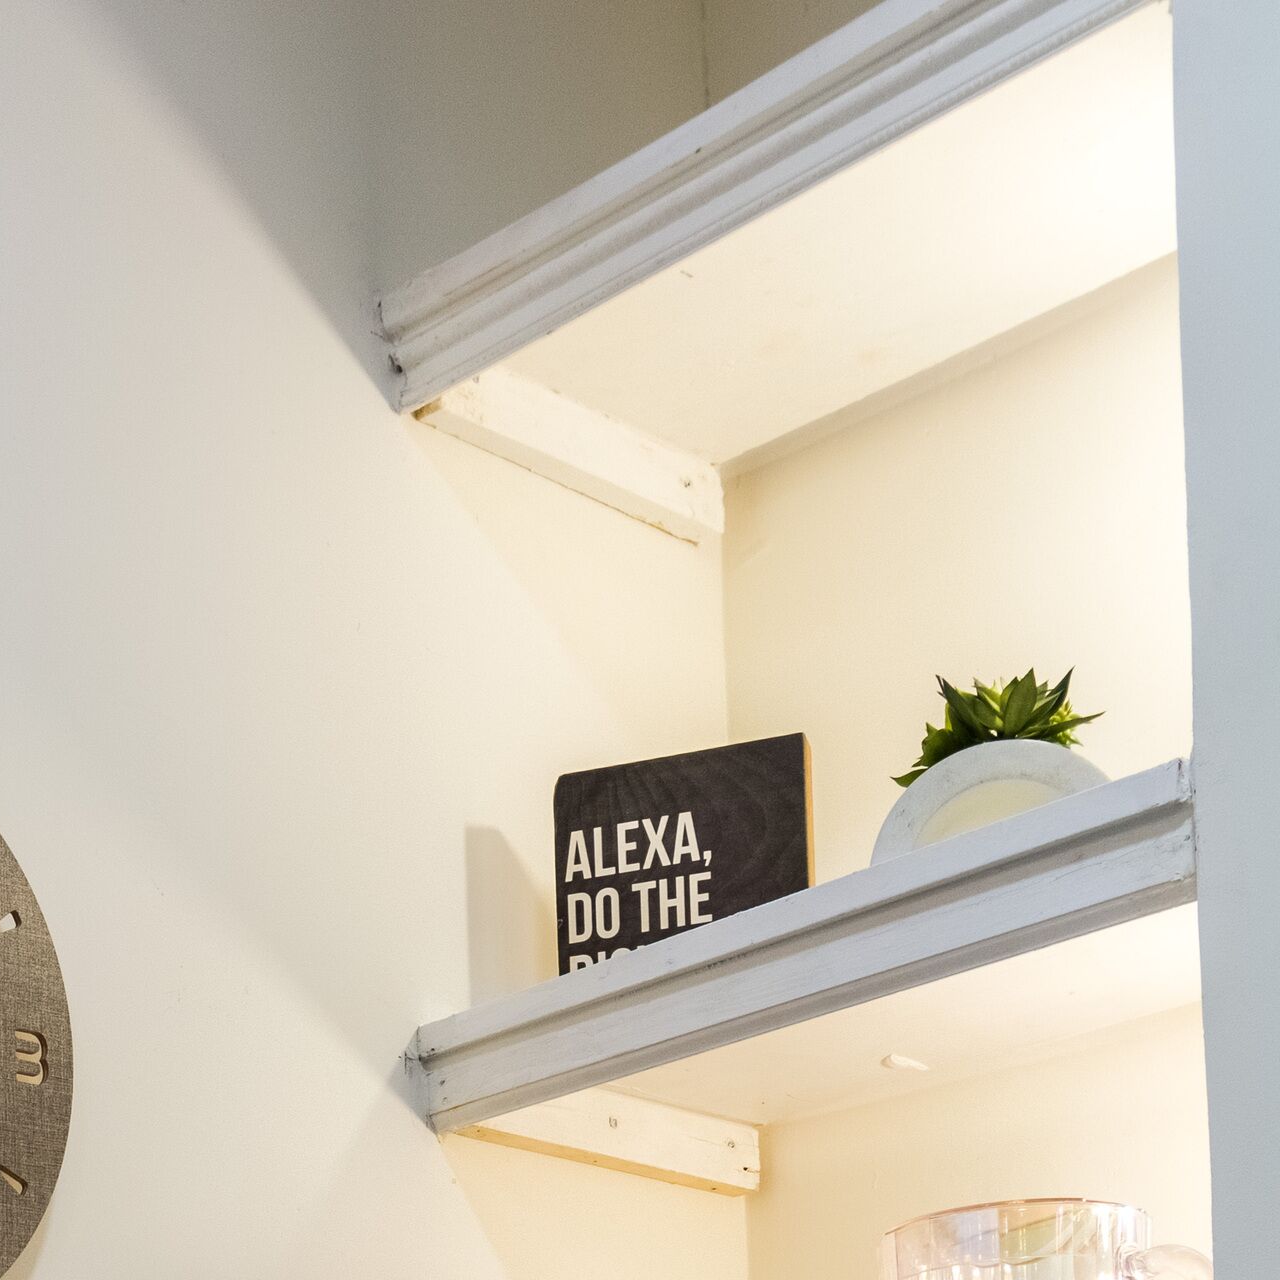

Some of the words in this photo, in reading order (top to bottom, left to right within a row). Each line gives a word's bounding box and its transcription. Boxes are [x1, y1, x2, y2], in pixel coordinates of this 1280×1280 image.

[565, 811, 712, 883] ALEXA,
[567, 887, 620, 944] DO
[631, 871, 713, 933] THE
[13, 1030, 49, 1086] 3
